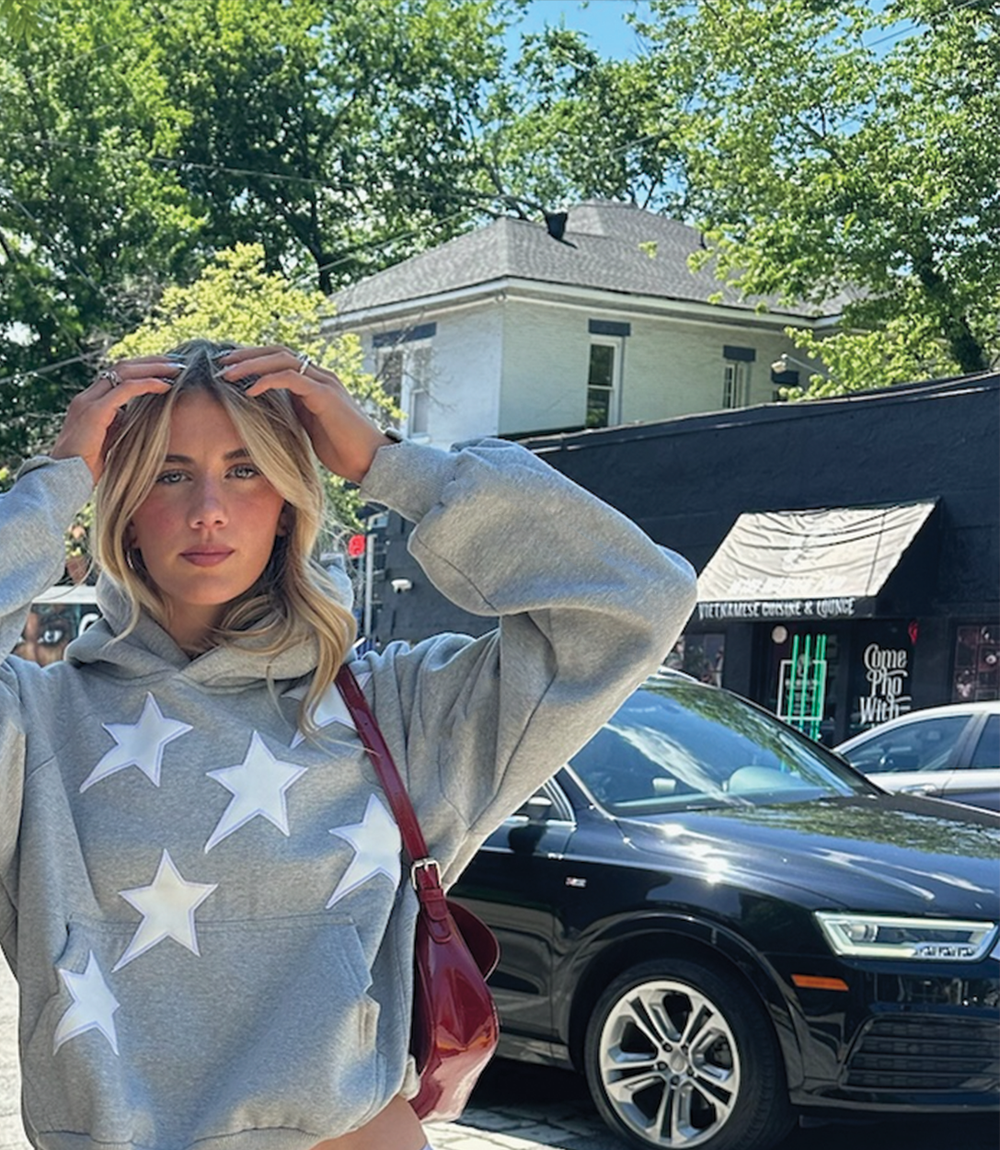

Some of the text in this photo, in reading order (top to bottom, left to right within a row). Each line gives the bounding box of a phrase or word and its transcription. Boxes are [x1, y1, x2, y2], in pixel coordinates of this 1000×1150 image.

[803, 601, 814, 615] &
[863, 643, 908, 671] Come
[866, 668, 908, 703] Pho
